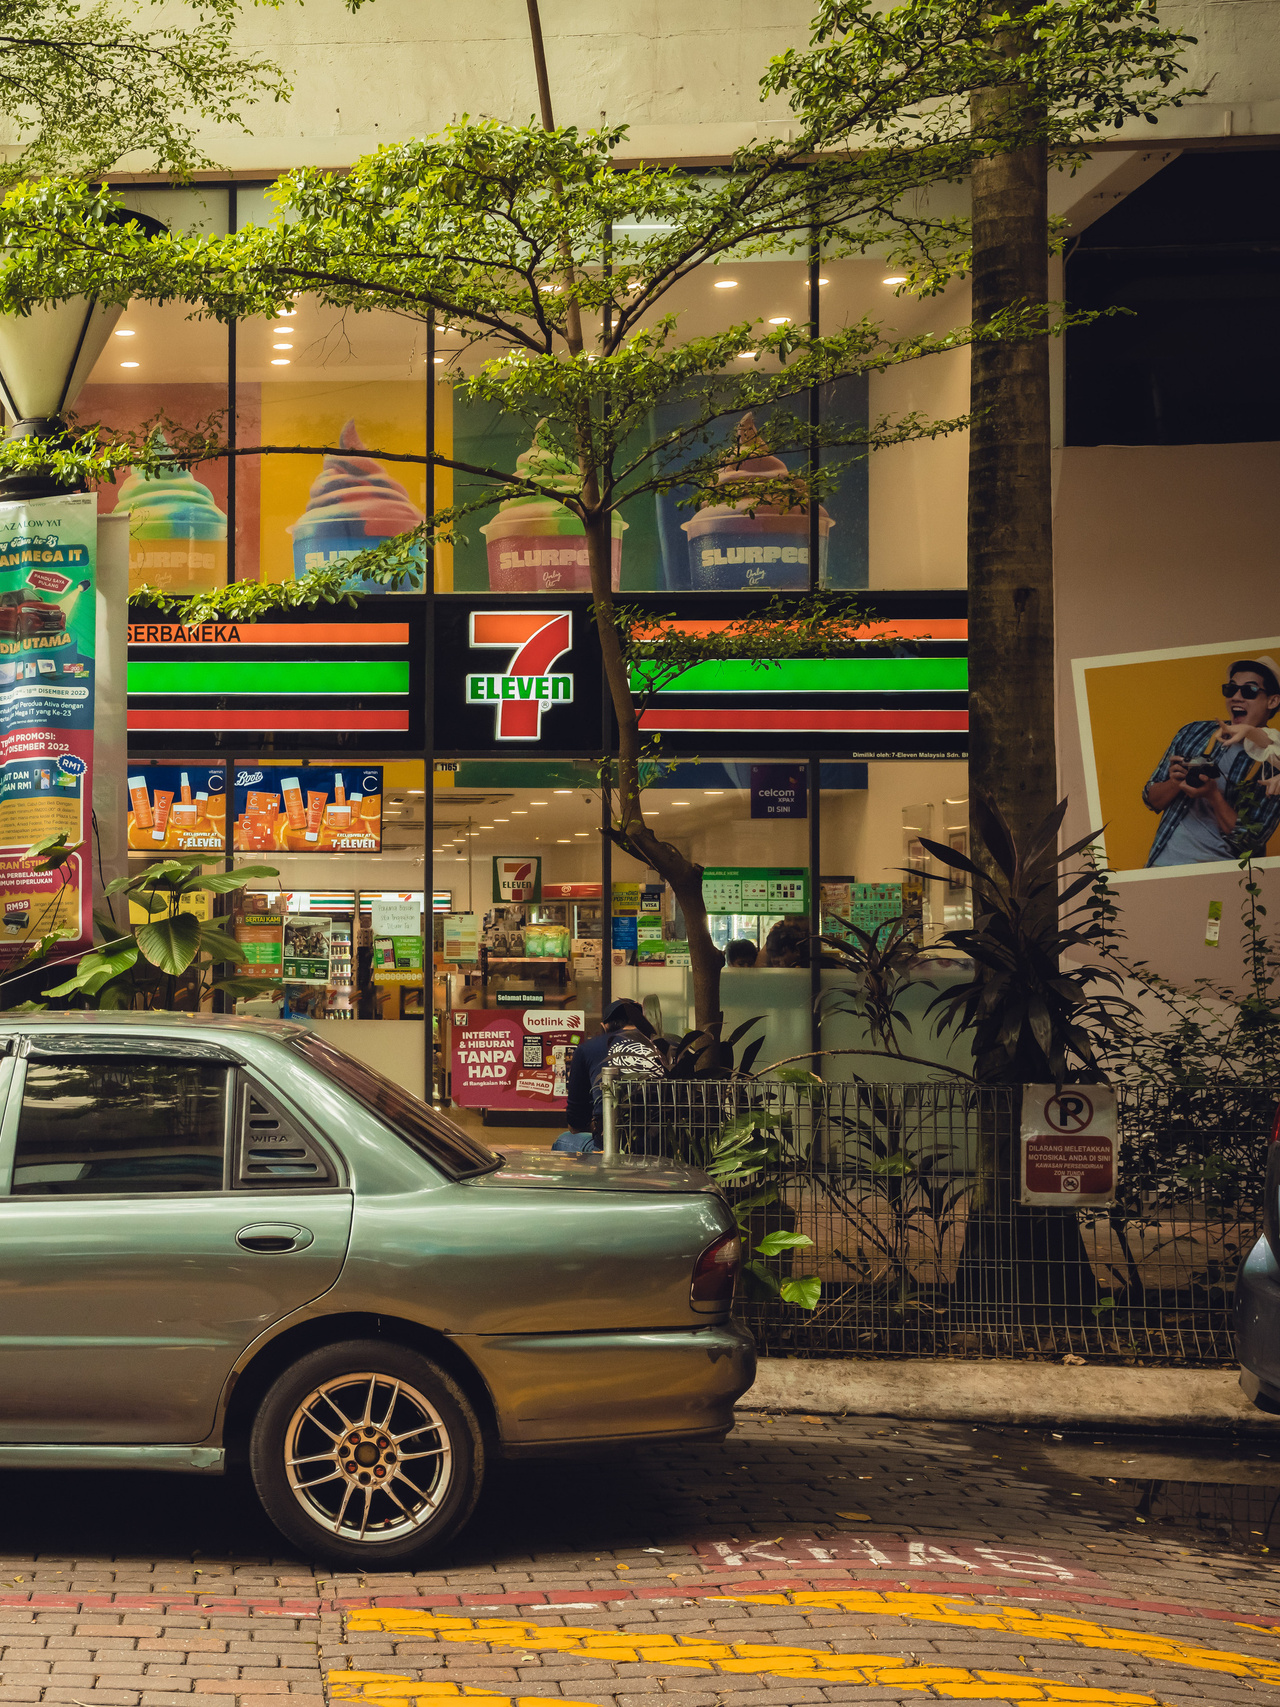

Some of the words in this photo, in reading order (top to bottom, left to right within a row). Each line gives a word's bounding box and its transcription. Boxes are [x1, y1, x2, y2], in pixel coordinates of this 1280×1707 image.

[24, 520, 45, 528] LOW
[46, 519, 62, 527] YAT
[21, 550, 64, 562] MEGA
[68, 549, 82, 561] IT
[500, 549, 590, 570] SLURPE
[38, 579, 58, 589] PULANG
[23, 633, 71, 650] UTAMA
[469, 611, 572, 741] 7
[61, 702, 84, 710] dengan
[36, 709, 51, 717] yang
[52, 709, 71, 717] Ke-23
[16, 732, 56, 743] PROMOSI:
[8, 742, 45, 753] DISEMBER
[48, 742, 70, 751] 2022
[62, 758, 81, 771] RM1
[440, 763, 457, 771] 1165
[13, 771, 29, 779] DAN
[234, 771, 264, 787] Boots
[18, 781, 32, 790] RM1
[207, 774, 224, 791] C
[362, 775, 378, 792] C
[758, 788, 795, 797] celcom
[16, 878, 53, 886] DIPERLUKAN
[6, 901, 29, 912] RM99
[522, 994, 543, 1002] Datang
[527, 1017, 564, 1026] hotlink
[462, 1031, 511, 1039] INTERNET
[459, 1041, 468, 1049] &
[469, 1040, 515, 1048] HIBURAN
[457, 1050, 517, 1064] TANPA
[468, 1065, 507, 1078] HAD
[1064, 1145, 1110, 1153] MELETAKKAN
[1097, 1154, 1111, 1162] SINI
[712, 1536, 1078, 1580] KHAS
